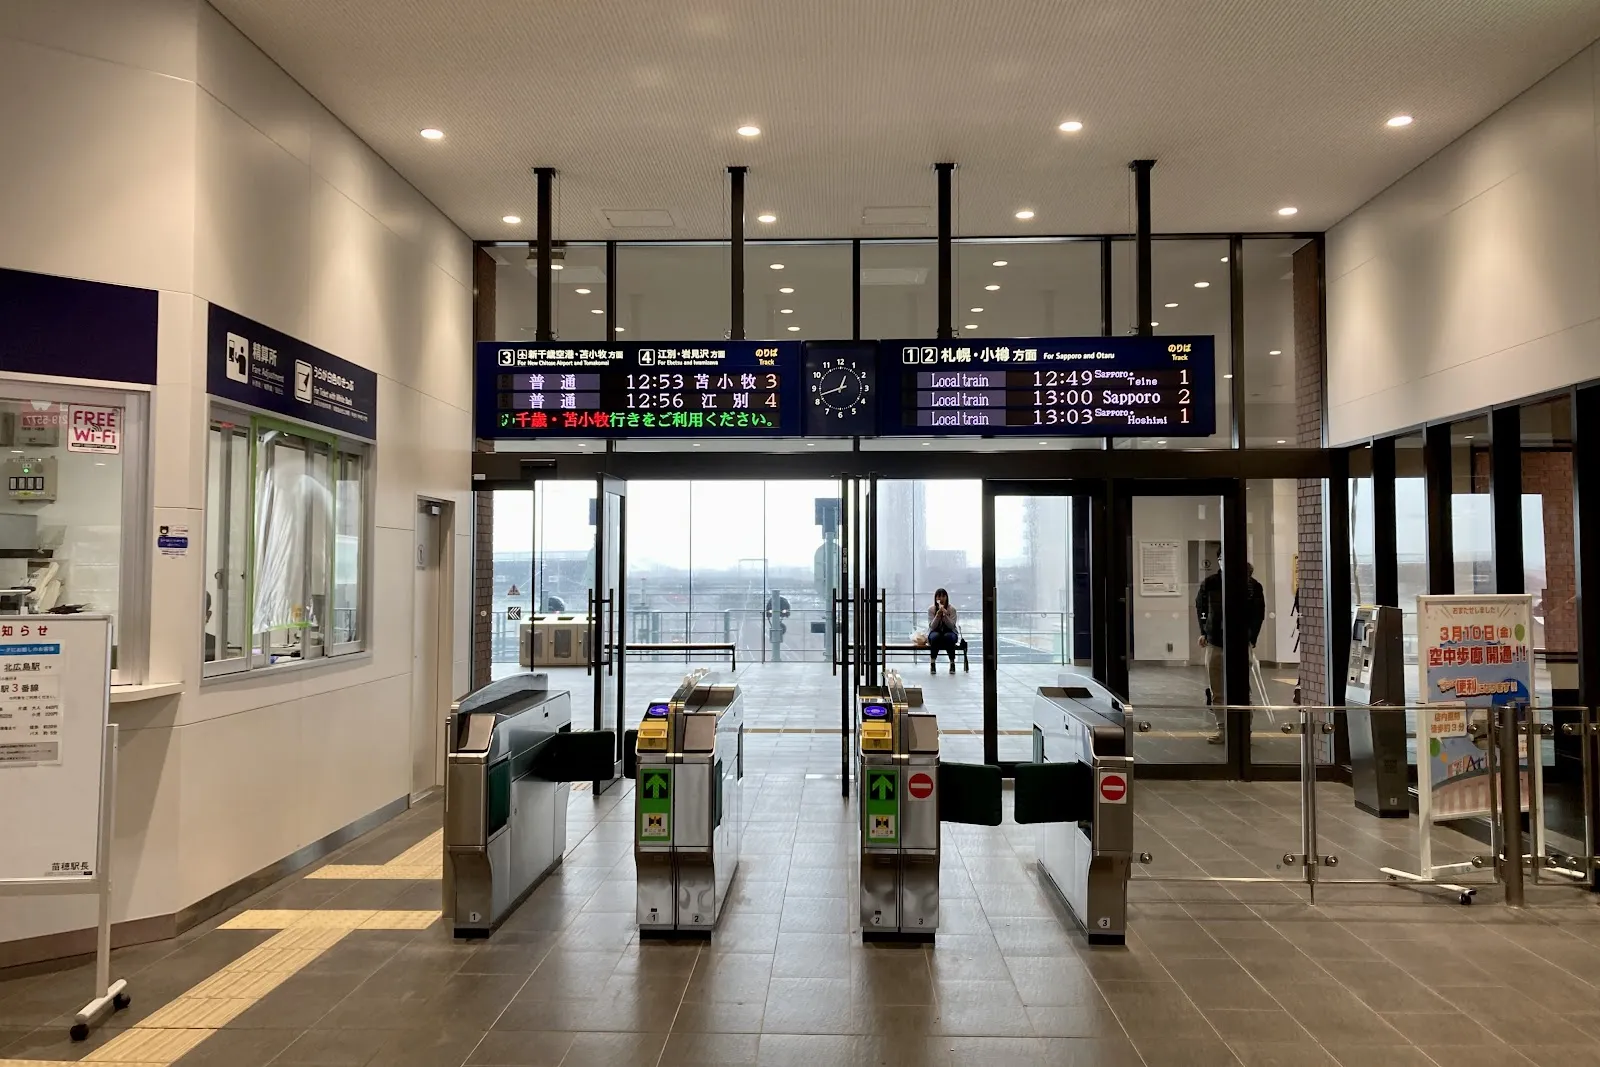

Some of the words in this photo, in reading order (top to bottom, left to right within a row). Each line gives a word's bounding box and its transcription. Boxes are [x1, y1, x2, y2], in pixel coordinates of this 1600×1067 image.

[642, 350, 652, 364] 4
[755, 348, 778, 358] のりば
[906, 349, 914, 362] 1
[924, 349, 934, 362] 2
[1056, 352, 1082, 360] Sapporo
[1168, 344, 1191, 352] のりば
[528, 374, 577, 390] 普通
[626, 374, 684, 390] 12:53
[694, 374, 757, 390] 苫小牧
[765, 374, 778, 390] 3
[931, 373, 960, 388] Local
[962, 373, 990, 388] train
[1033, 370, 1093, 386] 12:49
[1127, 376, 1158, 386] Teine
[1180, 369, 1190, 385] 1
[528, 392, 577, 409] 普通
[626, 393, 684, 408] 12:56
[701, 392, 750, 408] 江別
[764, 393, 778, 408] 4
[931, 392, 960, 407] Local
[962, 392, 990, 407] train
[1033, 390, 1093, 406] 13:00
[1102, 390, 1161, 406] Sapporo
[1178, 388, 1190, 404] 2
[74, 410, 116, 427] FREE
[931, 412, 960, 426] Local
[962, 412, 990, 426] train
[1033, 408, 1093, 424] 13:03
[1180, 408, 1190, 424] 1
[74, 426, 116, 444] Wi-Fi
